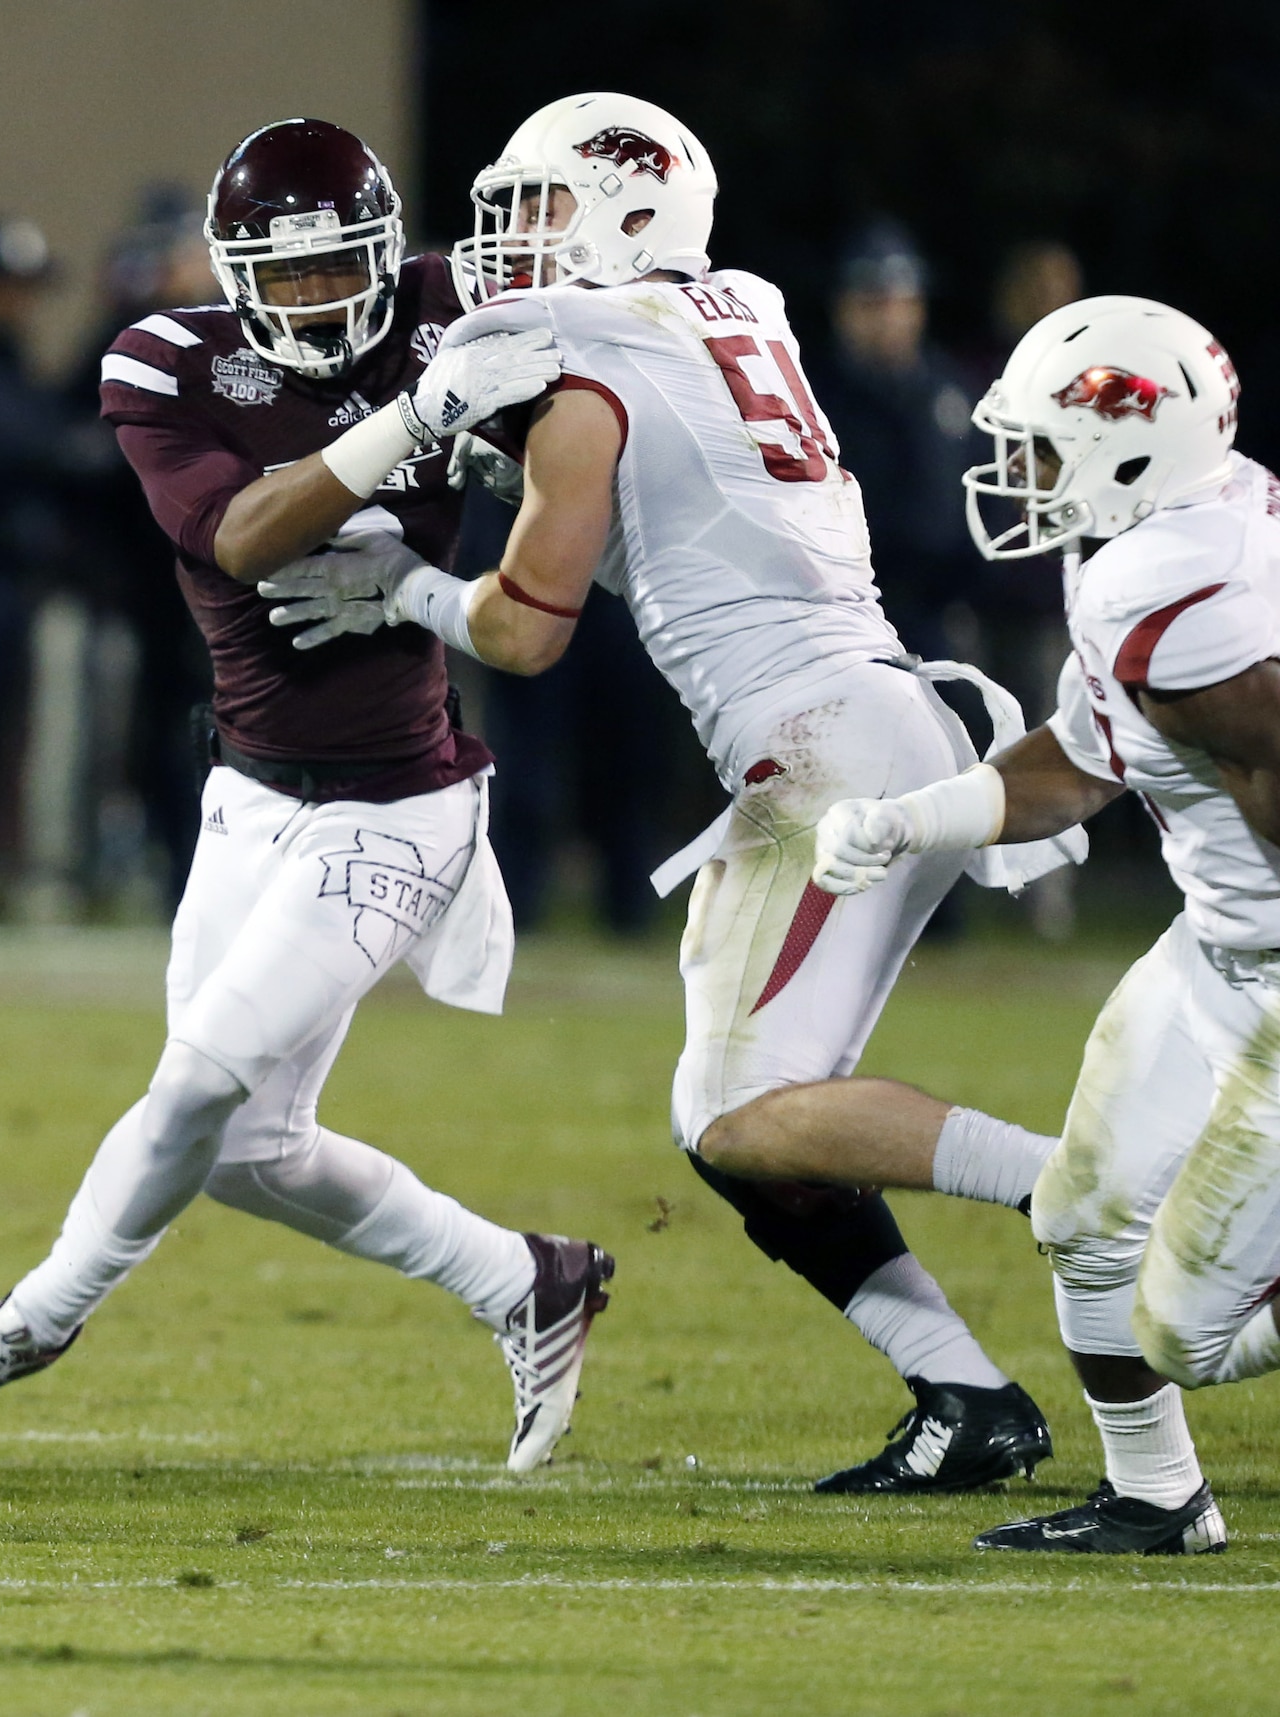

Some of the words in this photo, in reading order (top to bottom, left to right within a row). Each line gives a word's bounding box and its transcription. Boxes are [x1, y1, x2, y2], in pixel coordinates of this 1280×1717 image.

[678, 286, 760, 324] ELLIS
[216, 359, 248, 377] SCOTT
[248, 366, 278, 385] FIELD
[230, 383, 257, 401] 100
[703, 334, 853, 482] 51
[441, 400, 469, 428] adidas
[904, 1414, 954, 1478] NIKE
